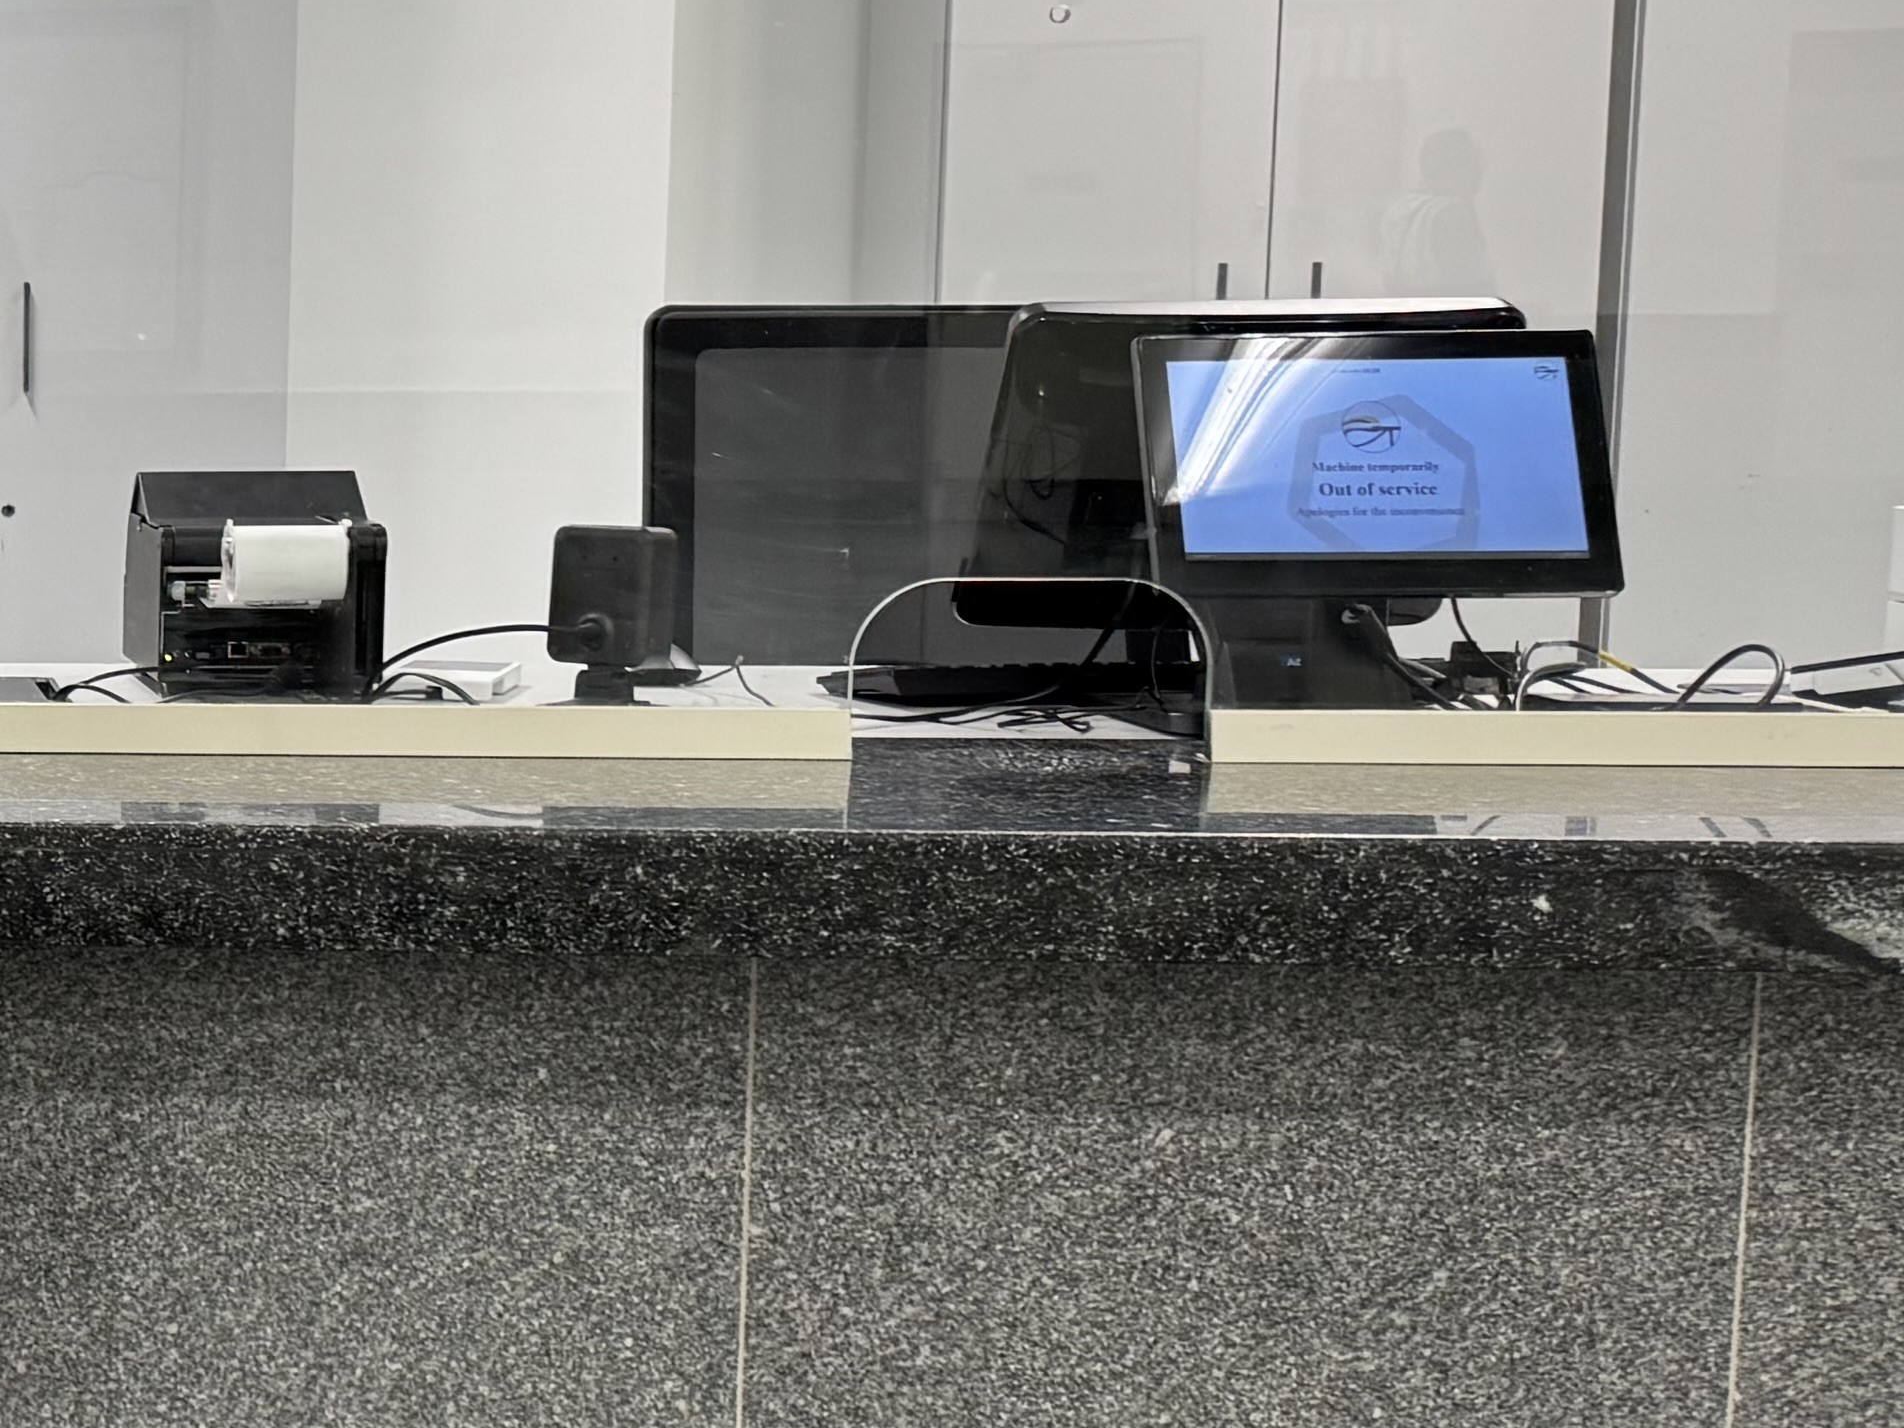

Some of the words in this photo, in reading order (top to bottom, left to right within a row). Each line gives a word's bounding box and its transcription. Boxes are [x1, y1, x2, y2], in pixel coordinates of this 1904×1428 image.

[1318, 482, 1352, 497] Out
[1357, 482, 1375, 497] of
[1378, 481, 1438, 496] service
